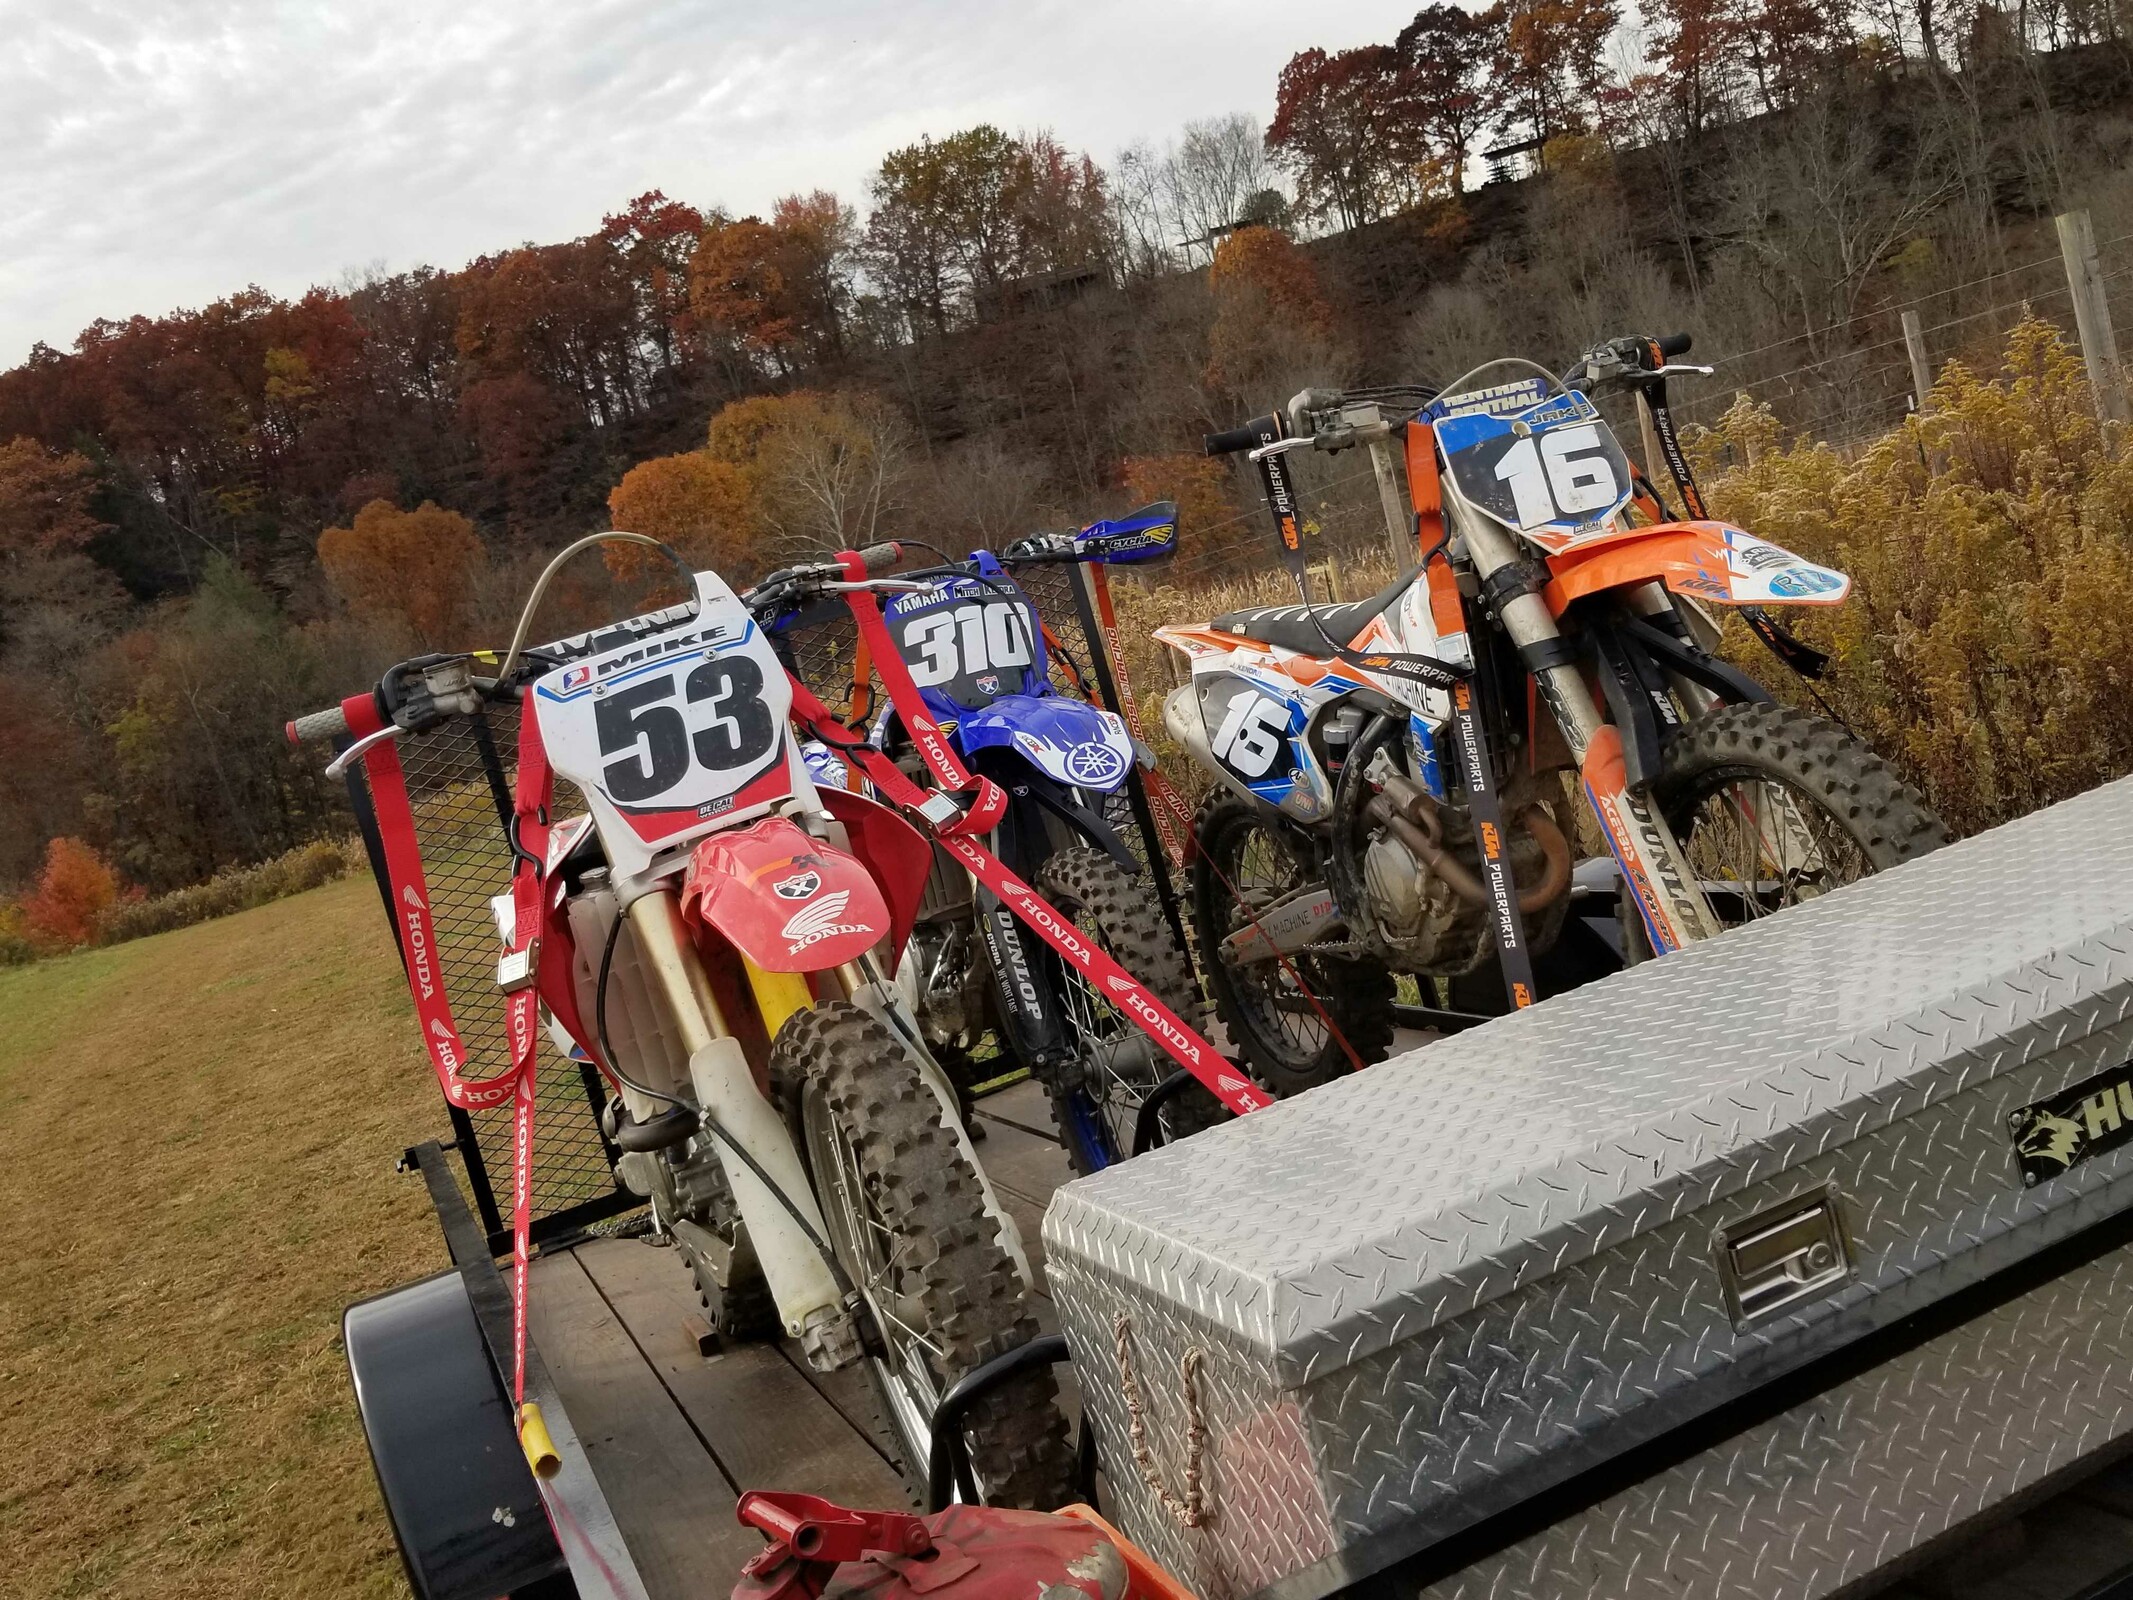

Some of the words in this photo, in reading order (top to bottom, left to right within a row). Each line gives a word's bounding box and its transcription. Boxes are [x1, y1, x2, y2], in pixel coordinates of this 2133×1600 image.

[1529, 404, 1590, 426] JAKE
[1656, 408, 1689, 482] POWERPARTS
[1494, 424, 1618, 531] 16
[1110, 535, 1152, 549] CYCRA
[894, 588, 950, 615] YAMAHA
[1677, 579, 1728, 594] KTM
[597, 625, 728, 677] MIKE
[903, 602, 1036, 689] 310
[1105, 627, 1132, 685] RACING
[593, 655, 775, 803] 53
[1211, 689, 1293, 778] 16
[1650, 690, 1677, 725] KTM
[922, 734, 965, 790] HONDA
[1459, 714, 1486, 792] POWERPARTS
[1160, 782, 1193, 822] ACING
[1295, 791, 1313, 811] UNI
[1481, 822, 1501, 860] KTM
[1019, 896, 1093, 966] HONDA
[1489, 863, 1516, 949] POWERPARTS
[406, 911, 435, 1001] HONDA
[787, 923, 875, 957] HONDA
[986, 932, 1002, 966] CYCRA
[997, 910, 1043, 1021] DUNLOP
[997, 968, 1008, 981] WE
[1000, 979, 1013, 998] WENT
[1006, 996, 1019, 1014] FAST
[1125, 993, 1201, 1067] HONDA
[518, 1103, 528, 1211] HONDA
